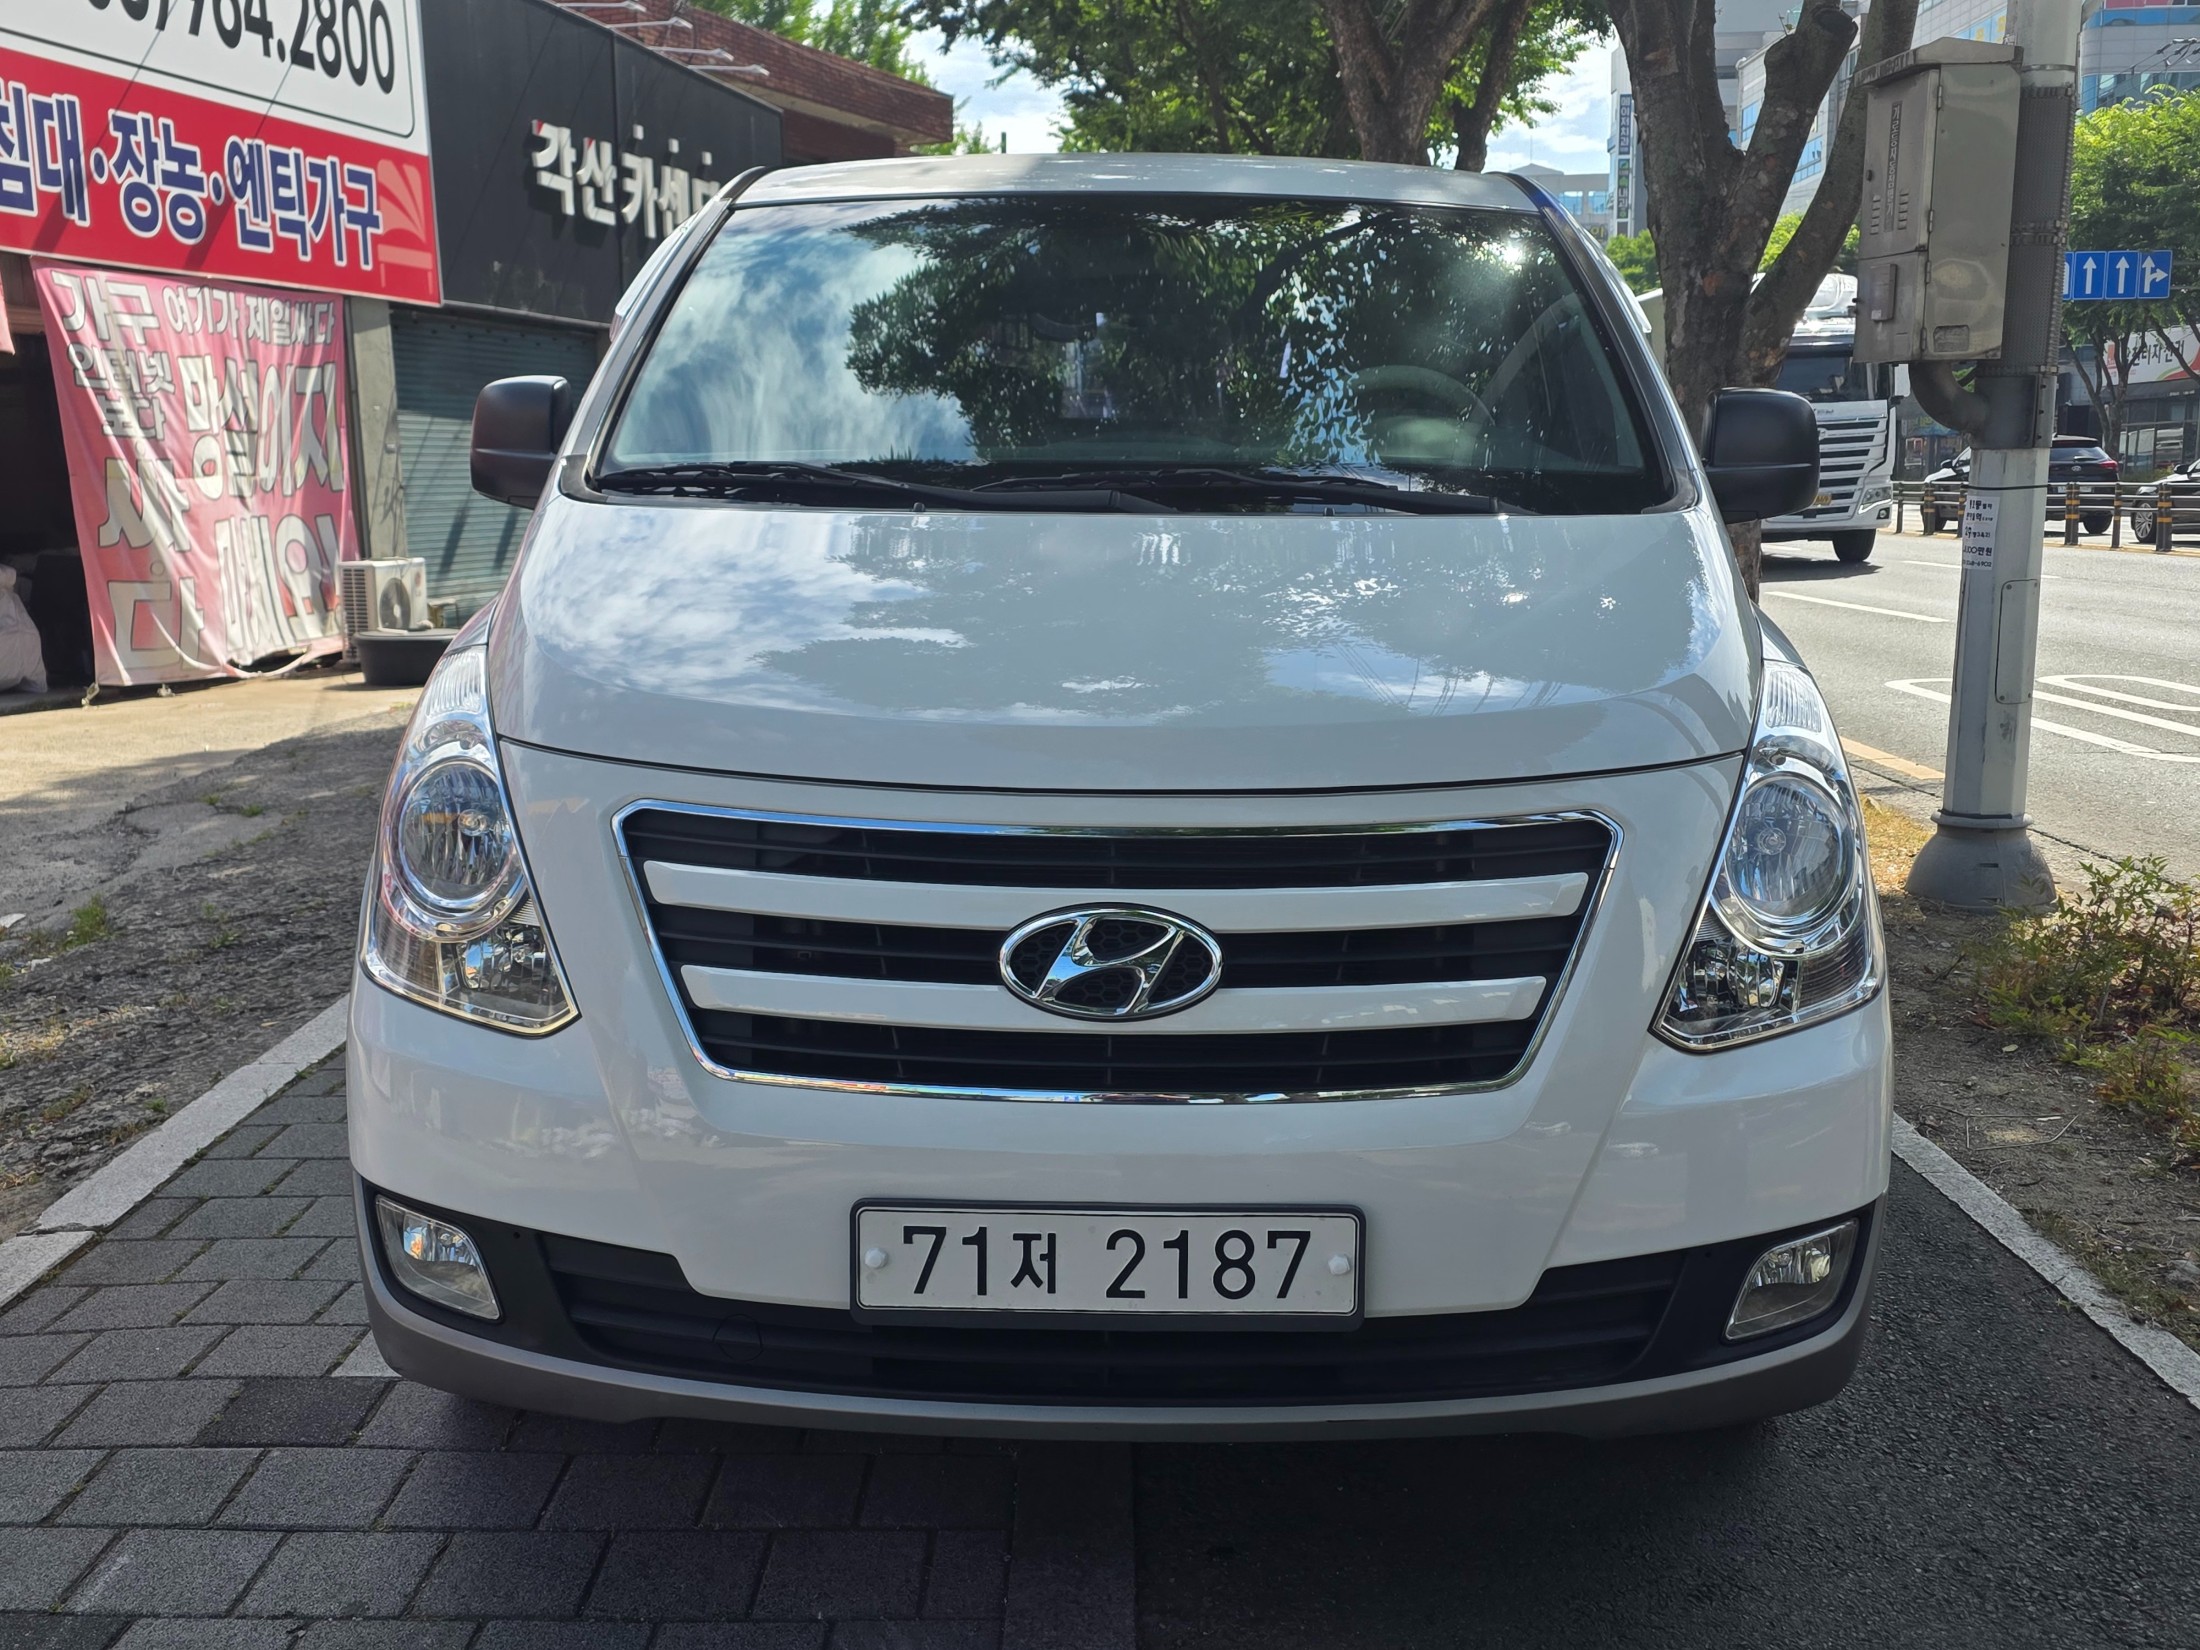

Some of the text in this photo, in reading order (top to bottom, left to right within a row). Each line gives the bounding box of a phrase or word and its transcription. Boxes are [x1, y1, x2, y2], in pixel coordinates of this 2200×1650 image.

[51, 271, 161, 345] 가구
[67, 343, 176, 394] 인터넷
[98, 394, 166, 441] 보다
[177, 352, 345, 501] 망설이지
[97, 457, 205, 671] 싸다
[902, 1226, 1311, 1299] 71저 2187
